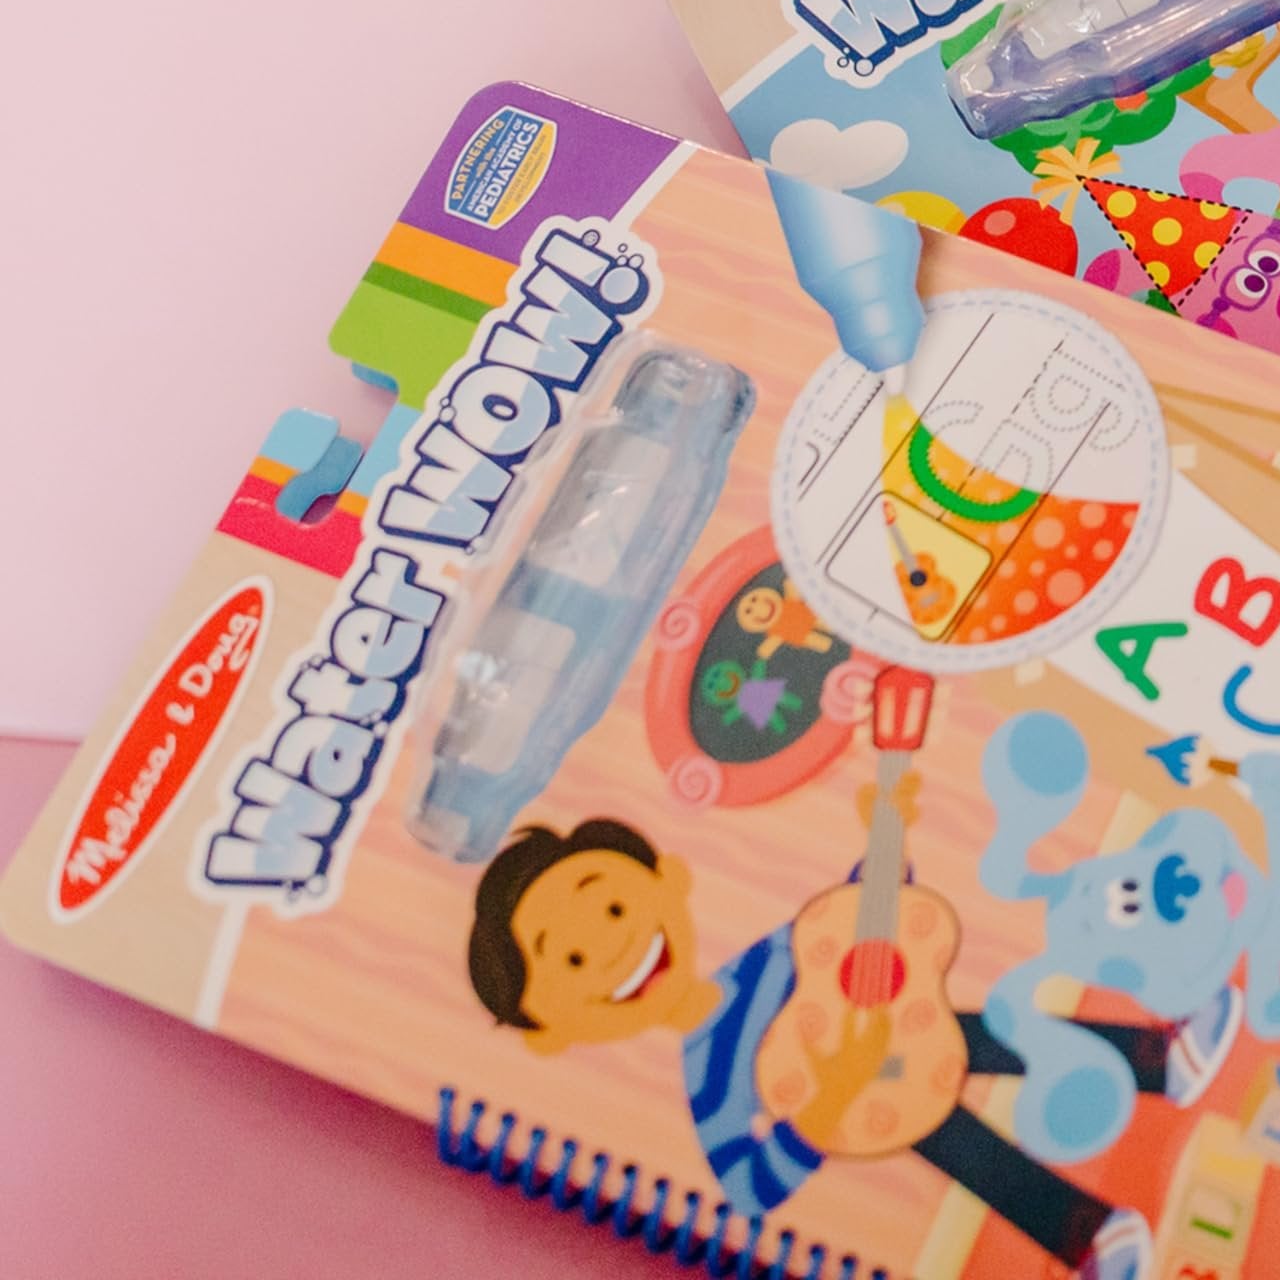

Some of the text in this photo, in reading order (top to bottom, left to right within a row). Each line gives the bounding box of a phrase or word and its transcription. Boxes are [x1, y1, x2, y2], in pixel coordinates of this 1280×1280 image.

[452, 119, 504, 200] PARTNERING
[467, 169, 494, 211] AMERICAN
[474, 122, 538, 217] PEDIATRICS
[1095, 622, 1188, 701] A
[67, 613, 259, 884] Melissa & Doug
[203, 547, 447, 889] Water
